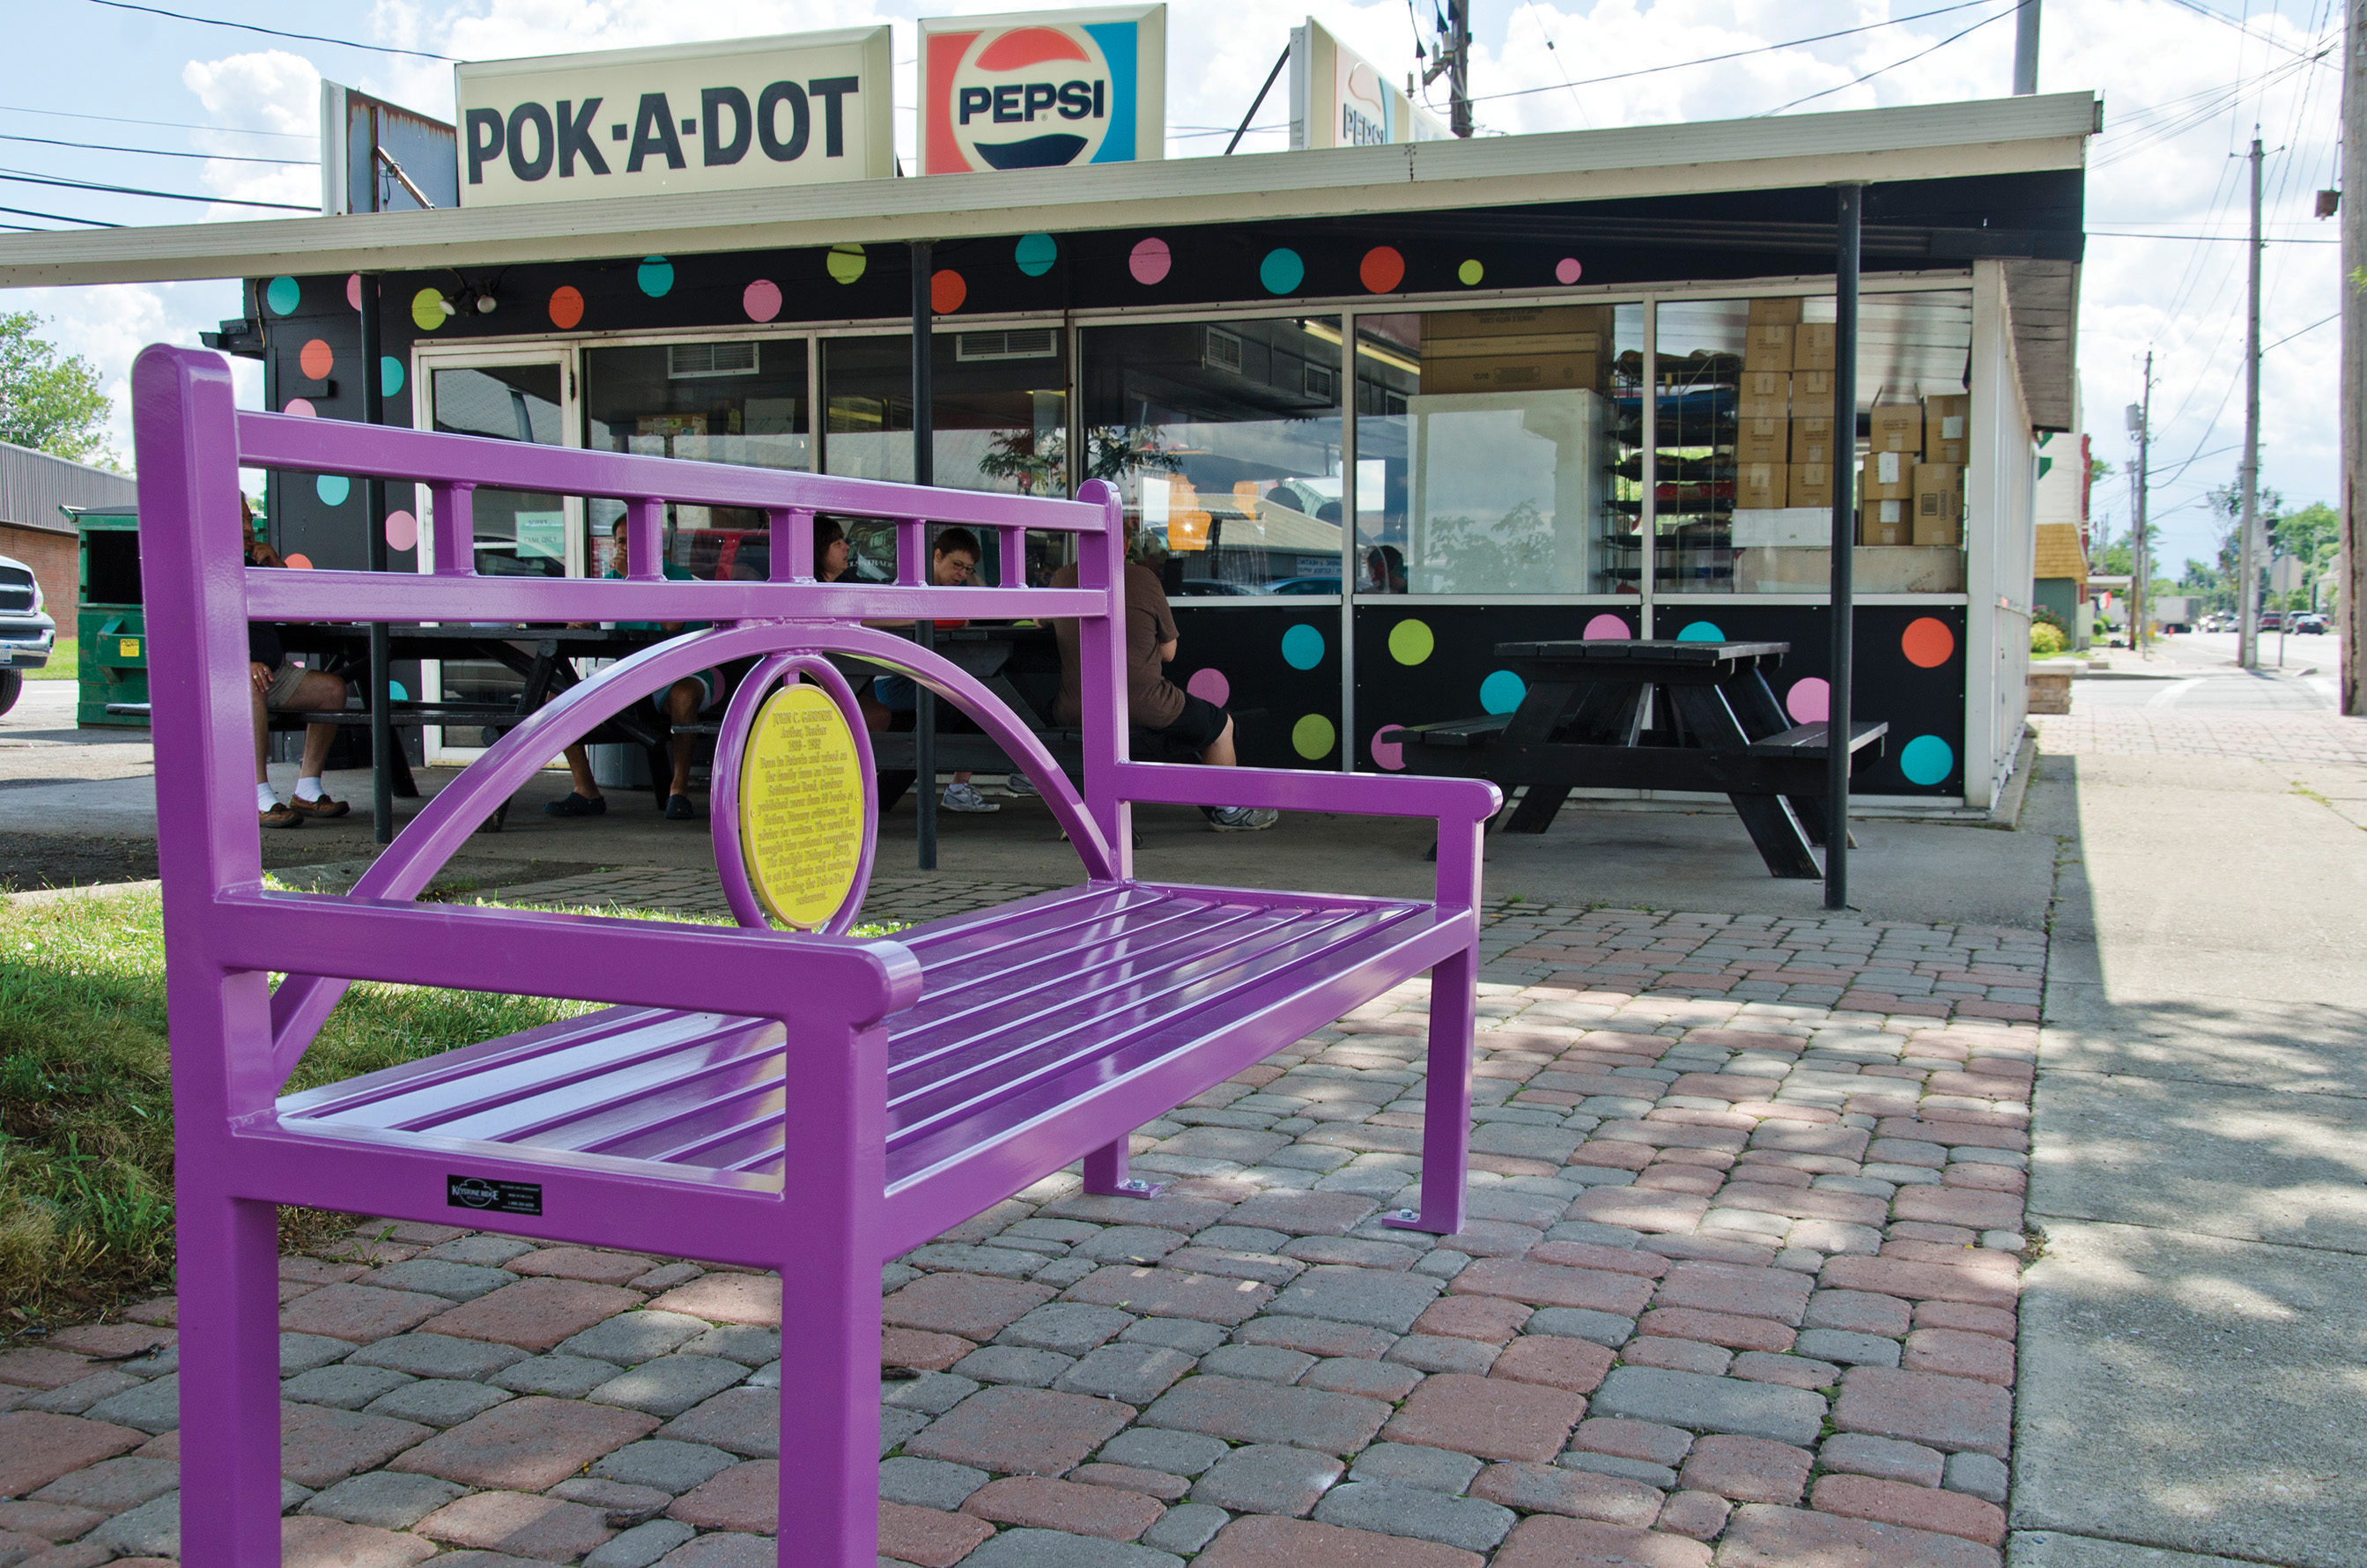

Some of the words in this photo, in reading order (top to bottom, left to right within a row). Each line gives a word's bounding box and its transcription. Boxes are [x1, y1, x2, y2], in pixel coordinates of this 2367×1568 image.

[959, 79, 1105, 125] PEPSI
[465, 76, 859, 184] POK-A-DOT
[803, 709, 832, 722] GARDNER
[809, 751, 819, 763] and
[822, 751, 839, 762] raised
[766, 770, 775, 782] the
[777, 768, 796, 783] family
[758, 797, 788, 817] published
[790, 798, 805, 808] more
[807, 794, 820, 806] than
[839, 802, 849, 815] and
[815, 820, 826, 832] The
[827, 817, 843, 831] novel
[845, 816, 855, 827] that
[798, 834, 822, 849] national
[815, 861, 826, 874] and
[806, 877, 816, 890] the
